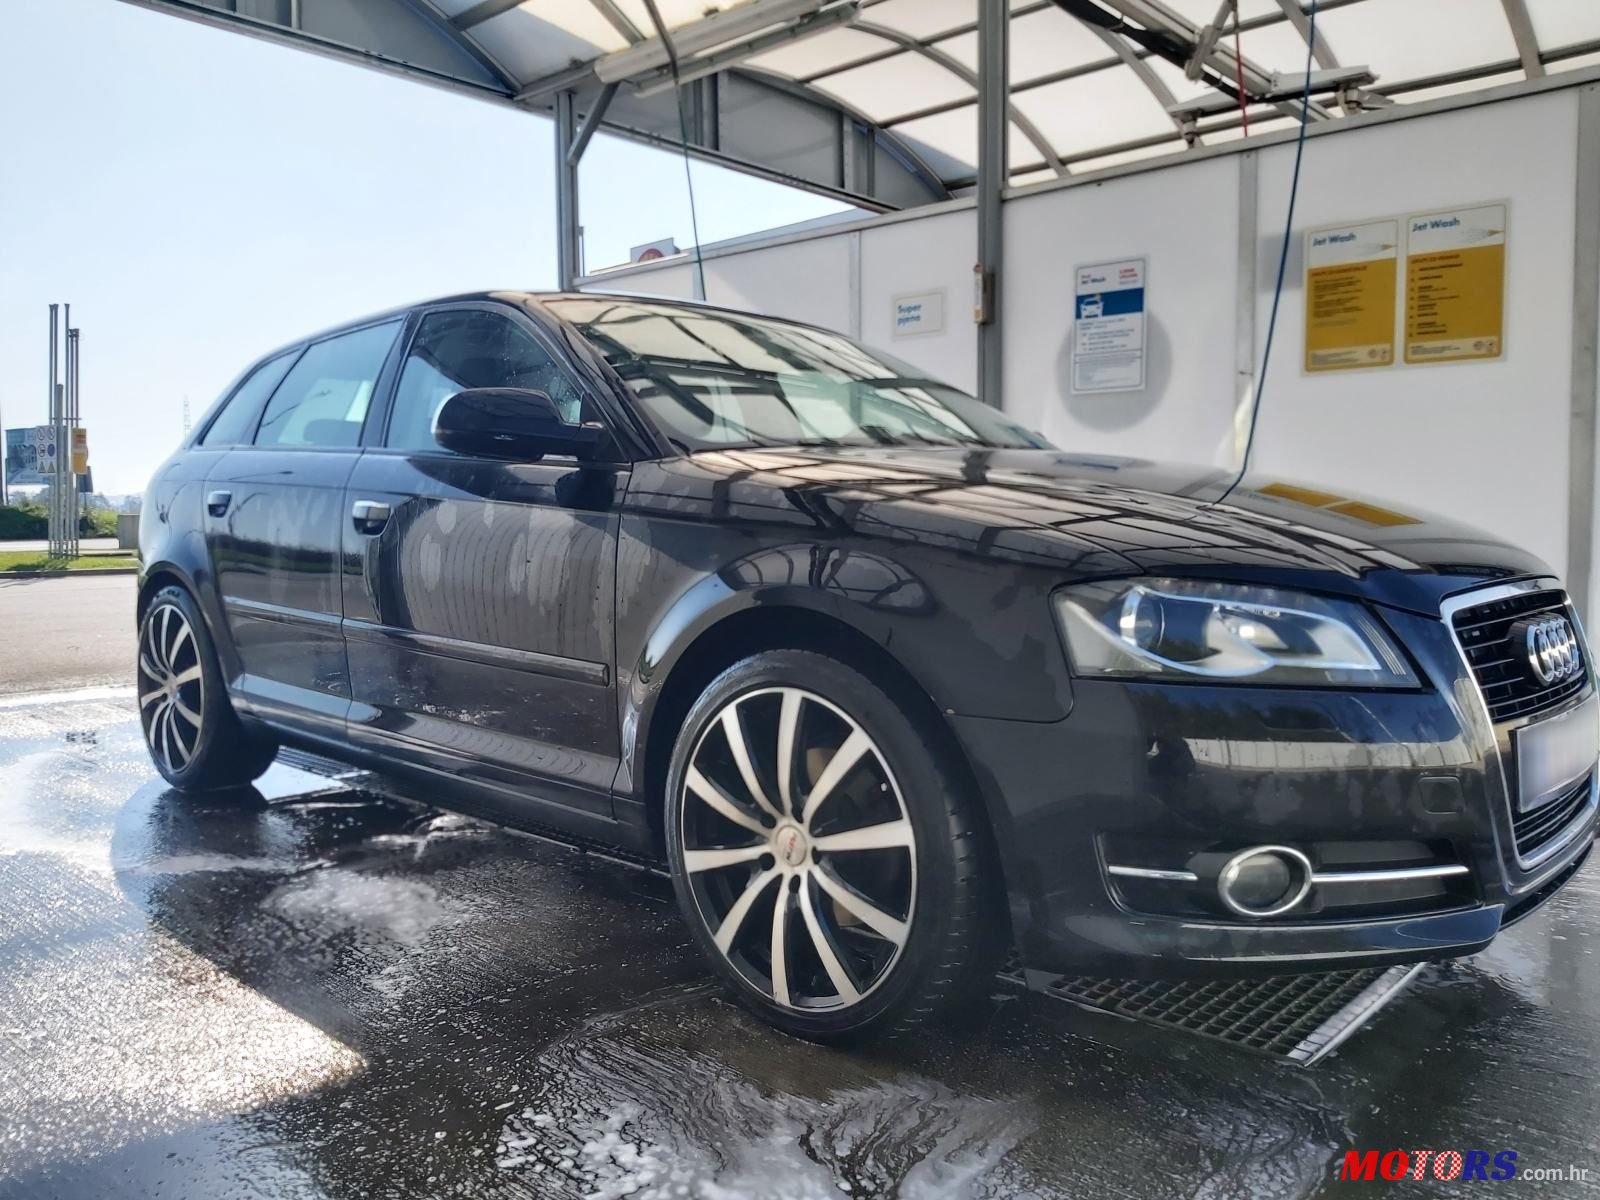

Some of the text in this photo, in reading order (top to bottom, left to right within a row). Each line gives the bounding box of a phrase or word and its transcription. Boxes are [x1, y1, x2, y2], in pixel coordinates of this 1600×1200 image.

[1412, 217, 1460, 232] Jet Wash
[1312, 232, 1356, 247] Jet Wash
[897, 304, 922, 314] Super
